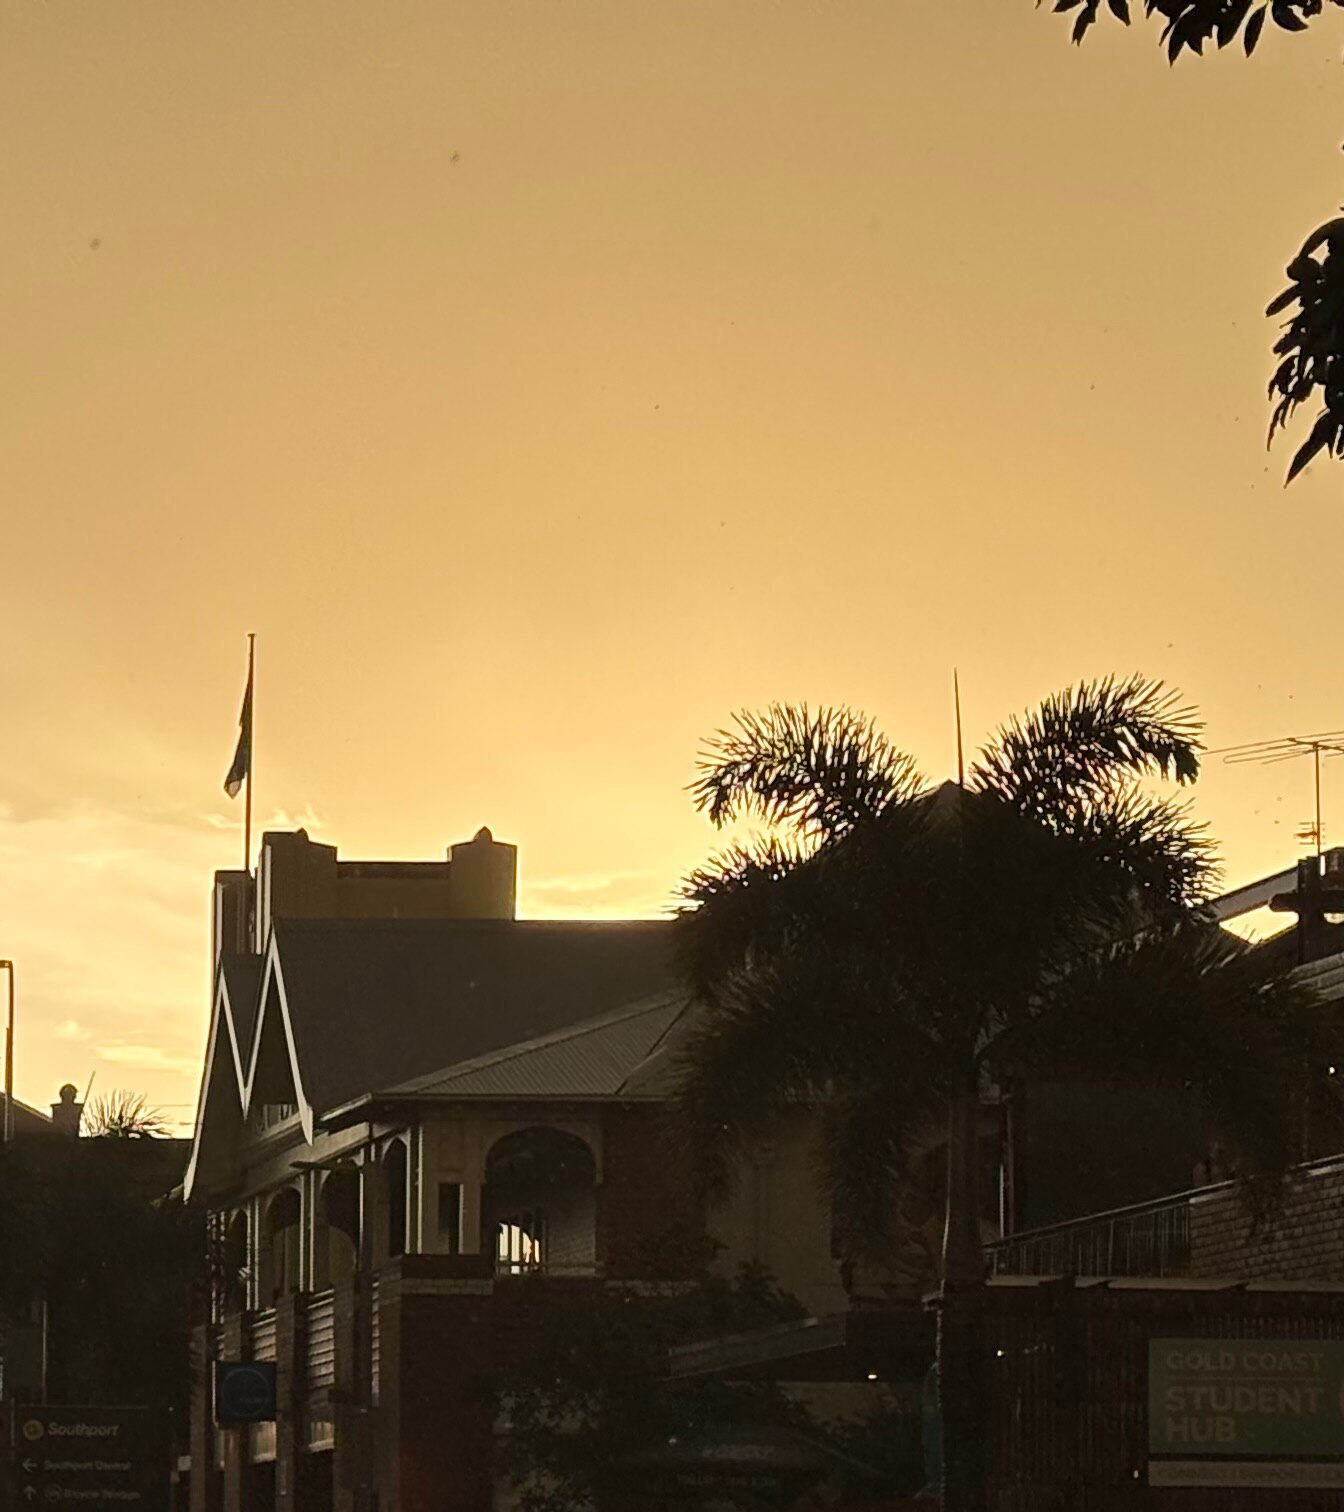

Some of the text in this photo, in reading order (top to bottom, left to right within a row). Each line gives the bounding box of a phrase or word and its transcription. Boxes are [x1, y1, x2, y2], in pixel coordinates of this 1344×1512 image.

[1166, 1352, 1324, 1372] GOLD COAST
[1165, 1386, 1325, 1414] STUDENT
[47, 1421, 120, 1438] Southport
[1166, 1416, 1237, 1442] HUB
